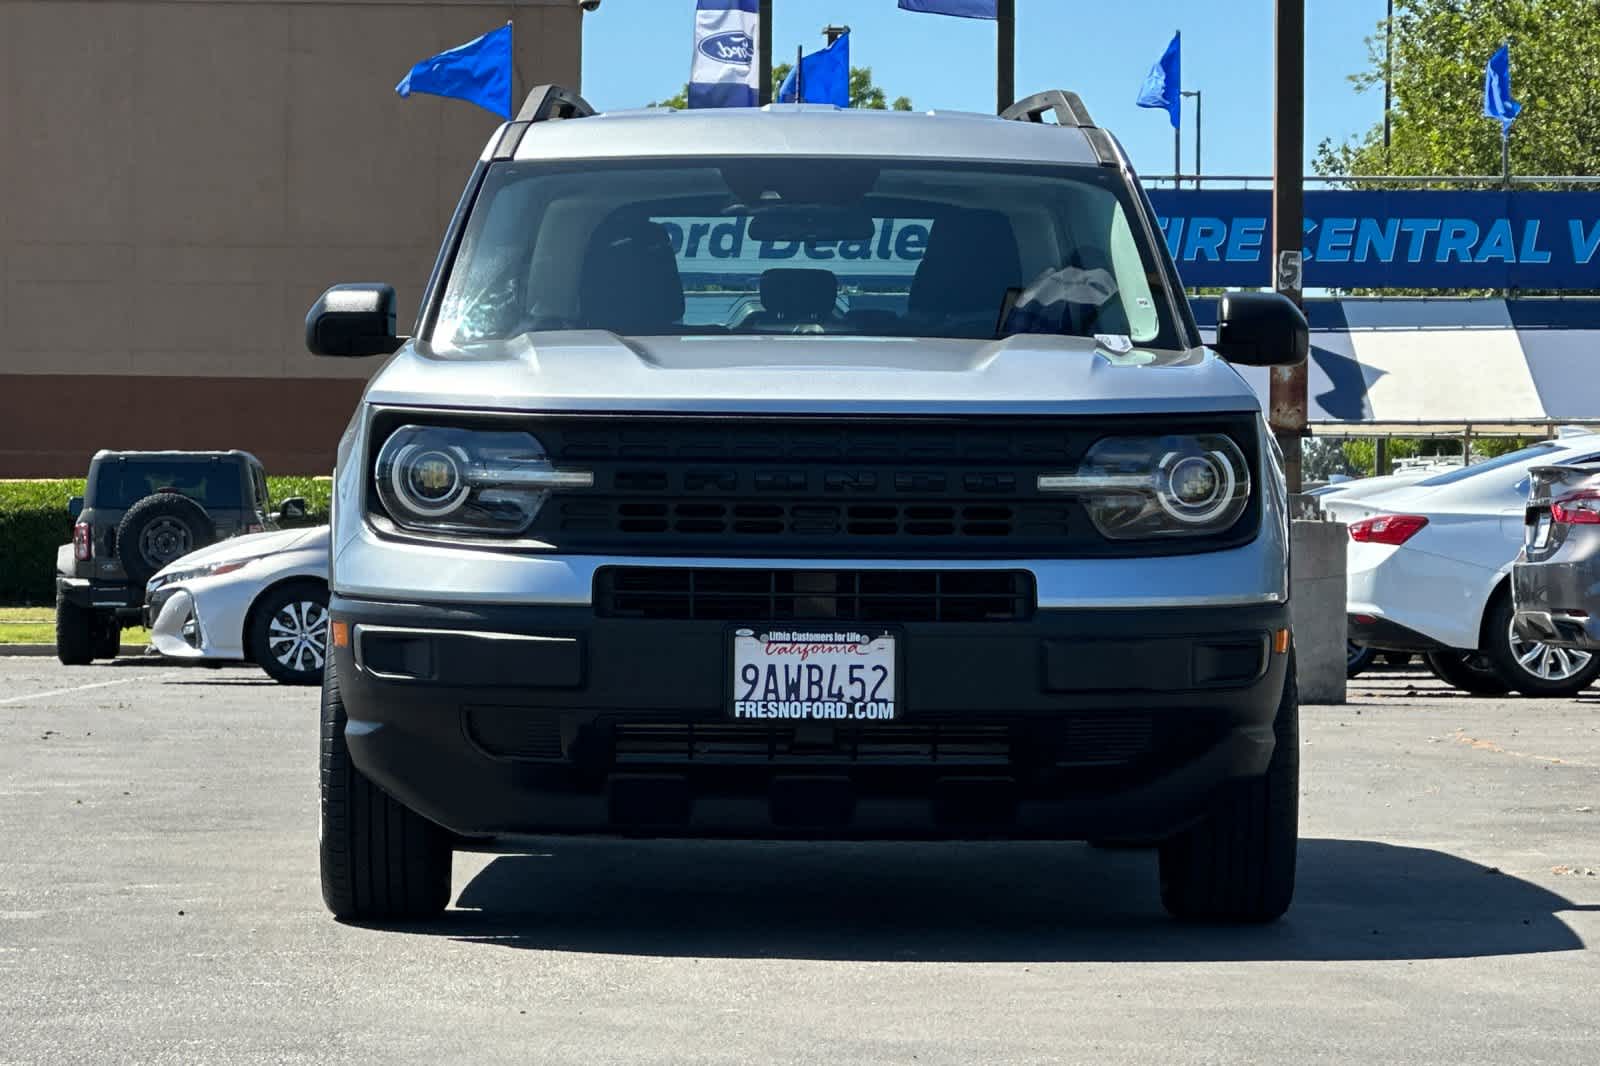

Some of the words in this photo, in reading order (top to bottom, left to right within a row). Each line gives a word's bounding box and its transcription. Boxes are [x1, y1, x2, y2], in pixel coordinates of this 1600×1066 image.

[1159, 217, 1267, 262] IRE
[769, 631, 791, 642] Lithia
[792, 632, 834, 642] Customers
[834, 632, 846, 642] for
[847, 632, 861, 642] Life
[765, 642, 869, 661] California
[741, 663, 889, 702] 9AWB452
[735, 701, 894, 719] FRESNOFORD.COM
